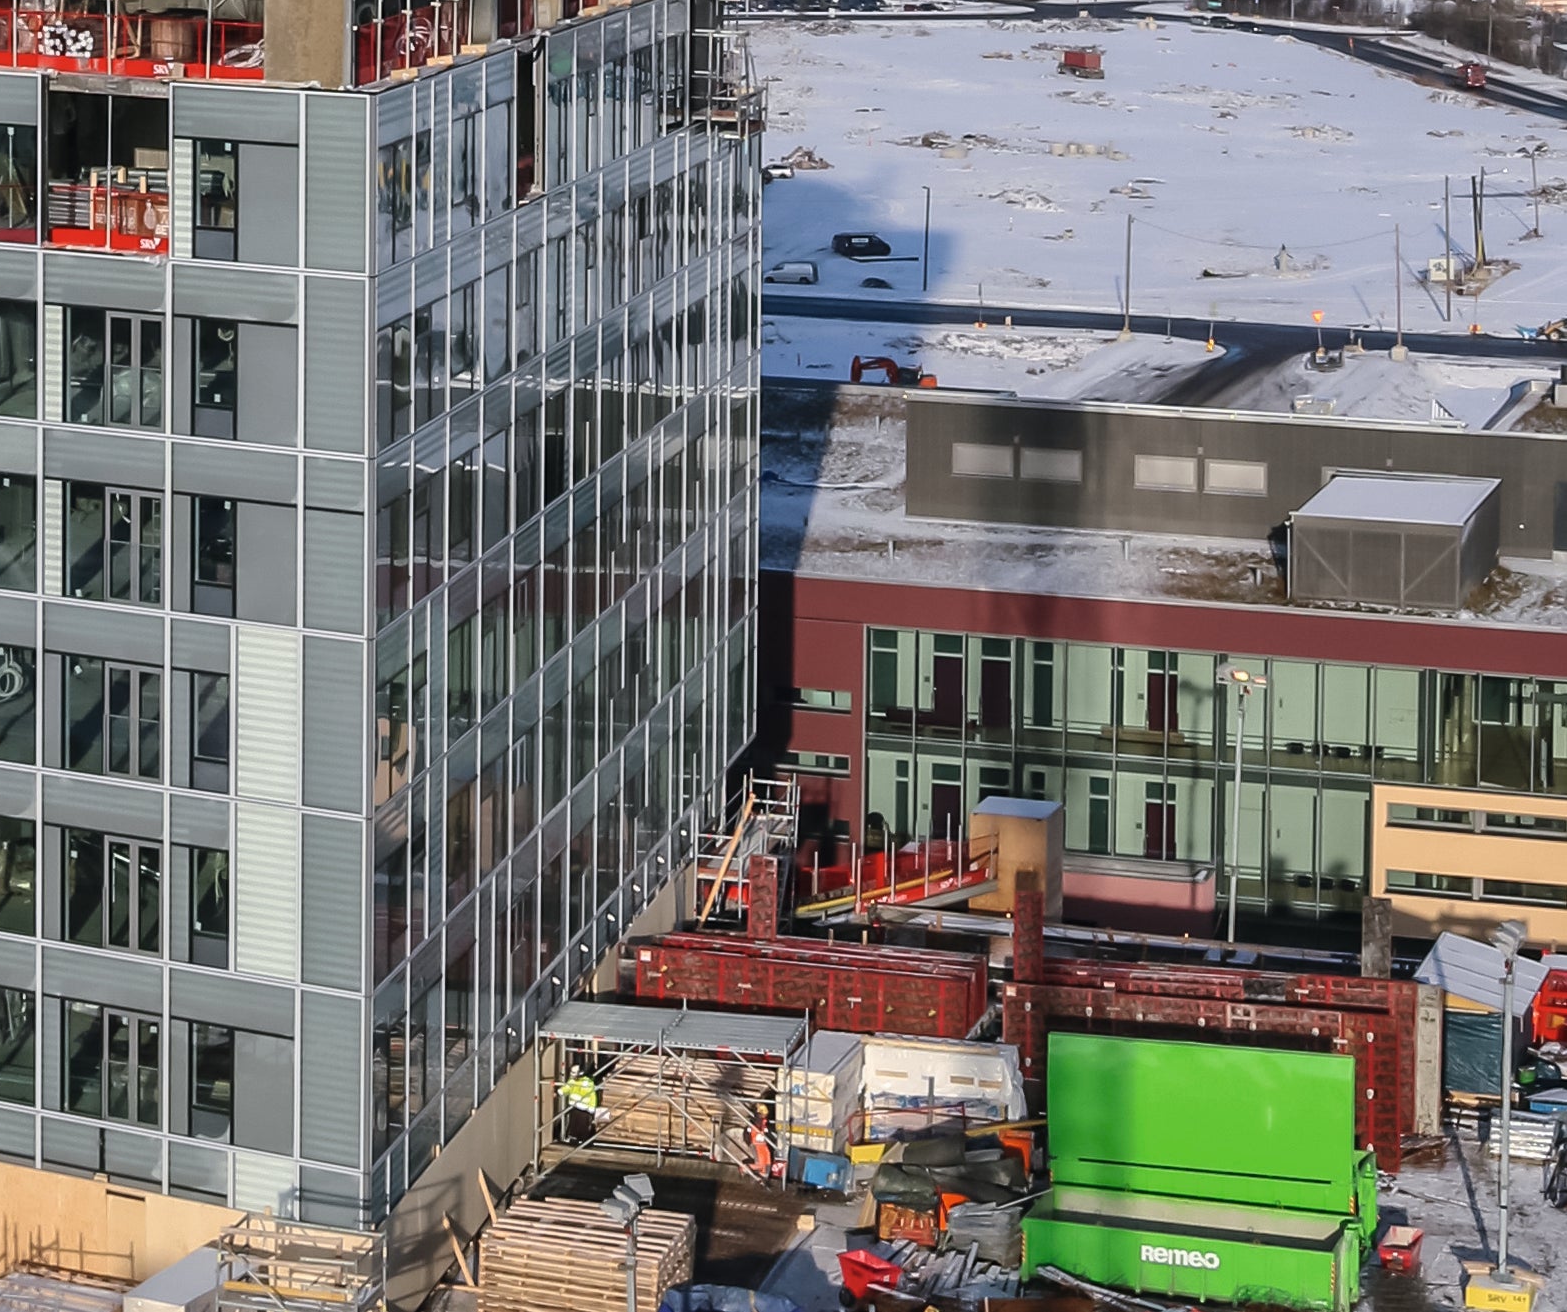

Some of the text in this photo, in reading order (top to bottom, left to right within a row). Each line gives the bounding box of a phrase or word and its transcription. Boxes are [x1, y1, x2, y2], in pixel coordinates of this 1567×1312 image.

[154, 63, 173, 74] SRV
[140, 238, 161, 249] SRV
[1487, 1293, 1507, 1303] SRV
